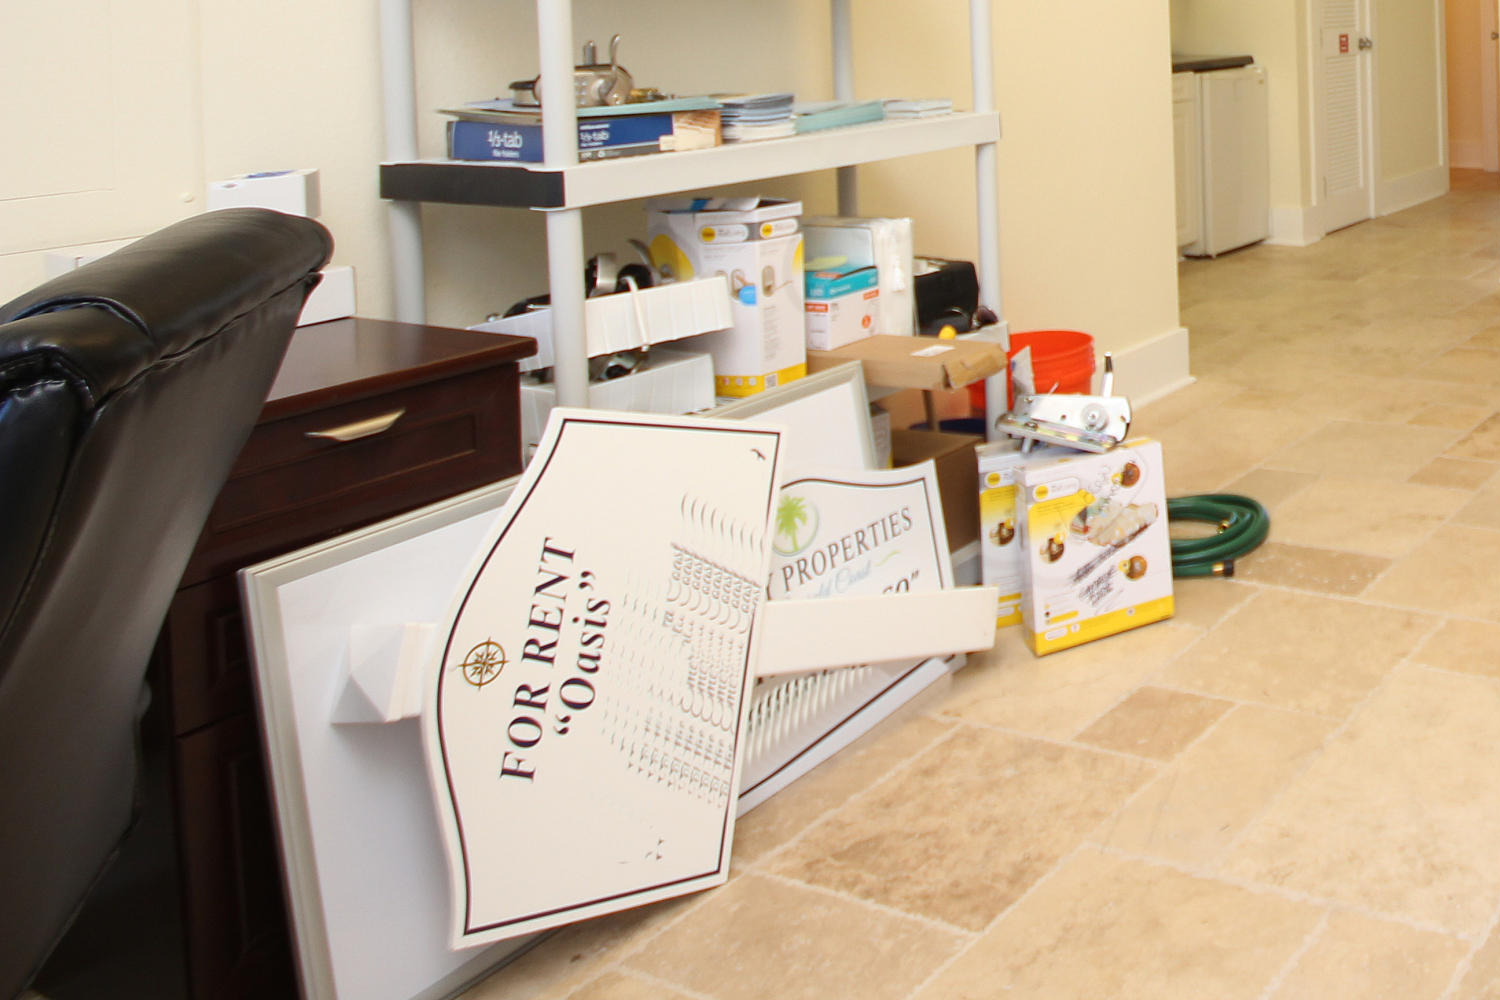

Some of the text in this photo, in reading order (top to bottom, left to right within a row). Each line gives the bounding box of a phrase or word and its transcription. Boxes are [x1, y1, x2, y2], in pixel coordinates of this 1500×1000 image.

[782, 506, 913, 593] PROPERTIES
[499, 536, 576, 784] FOR RENT
